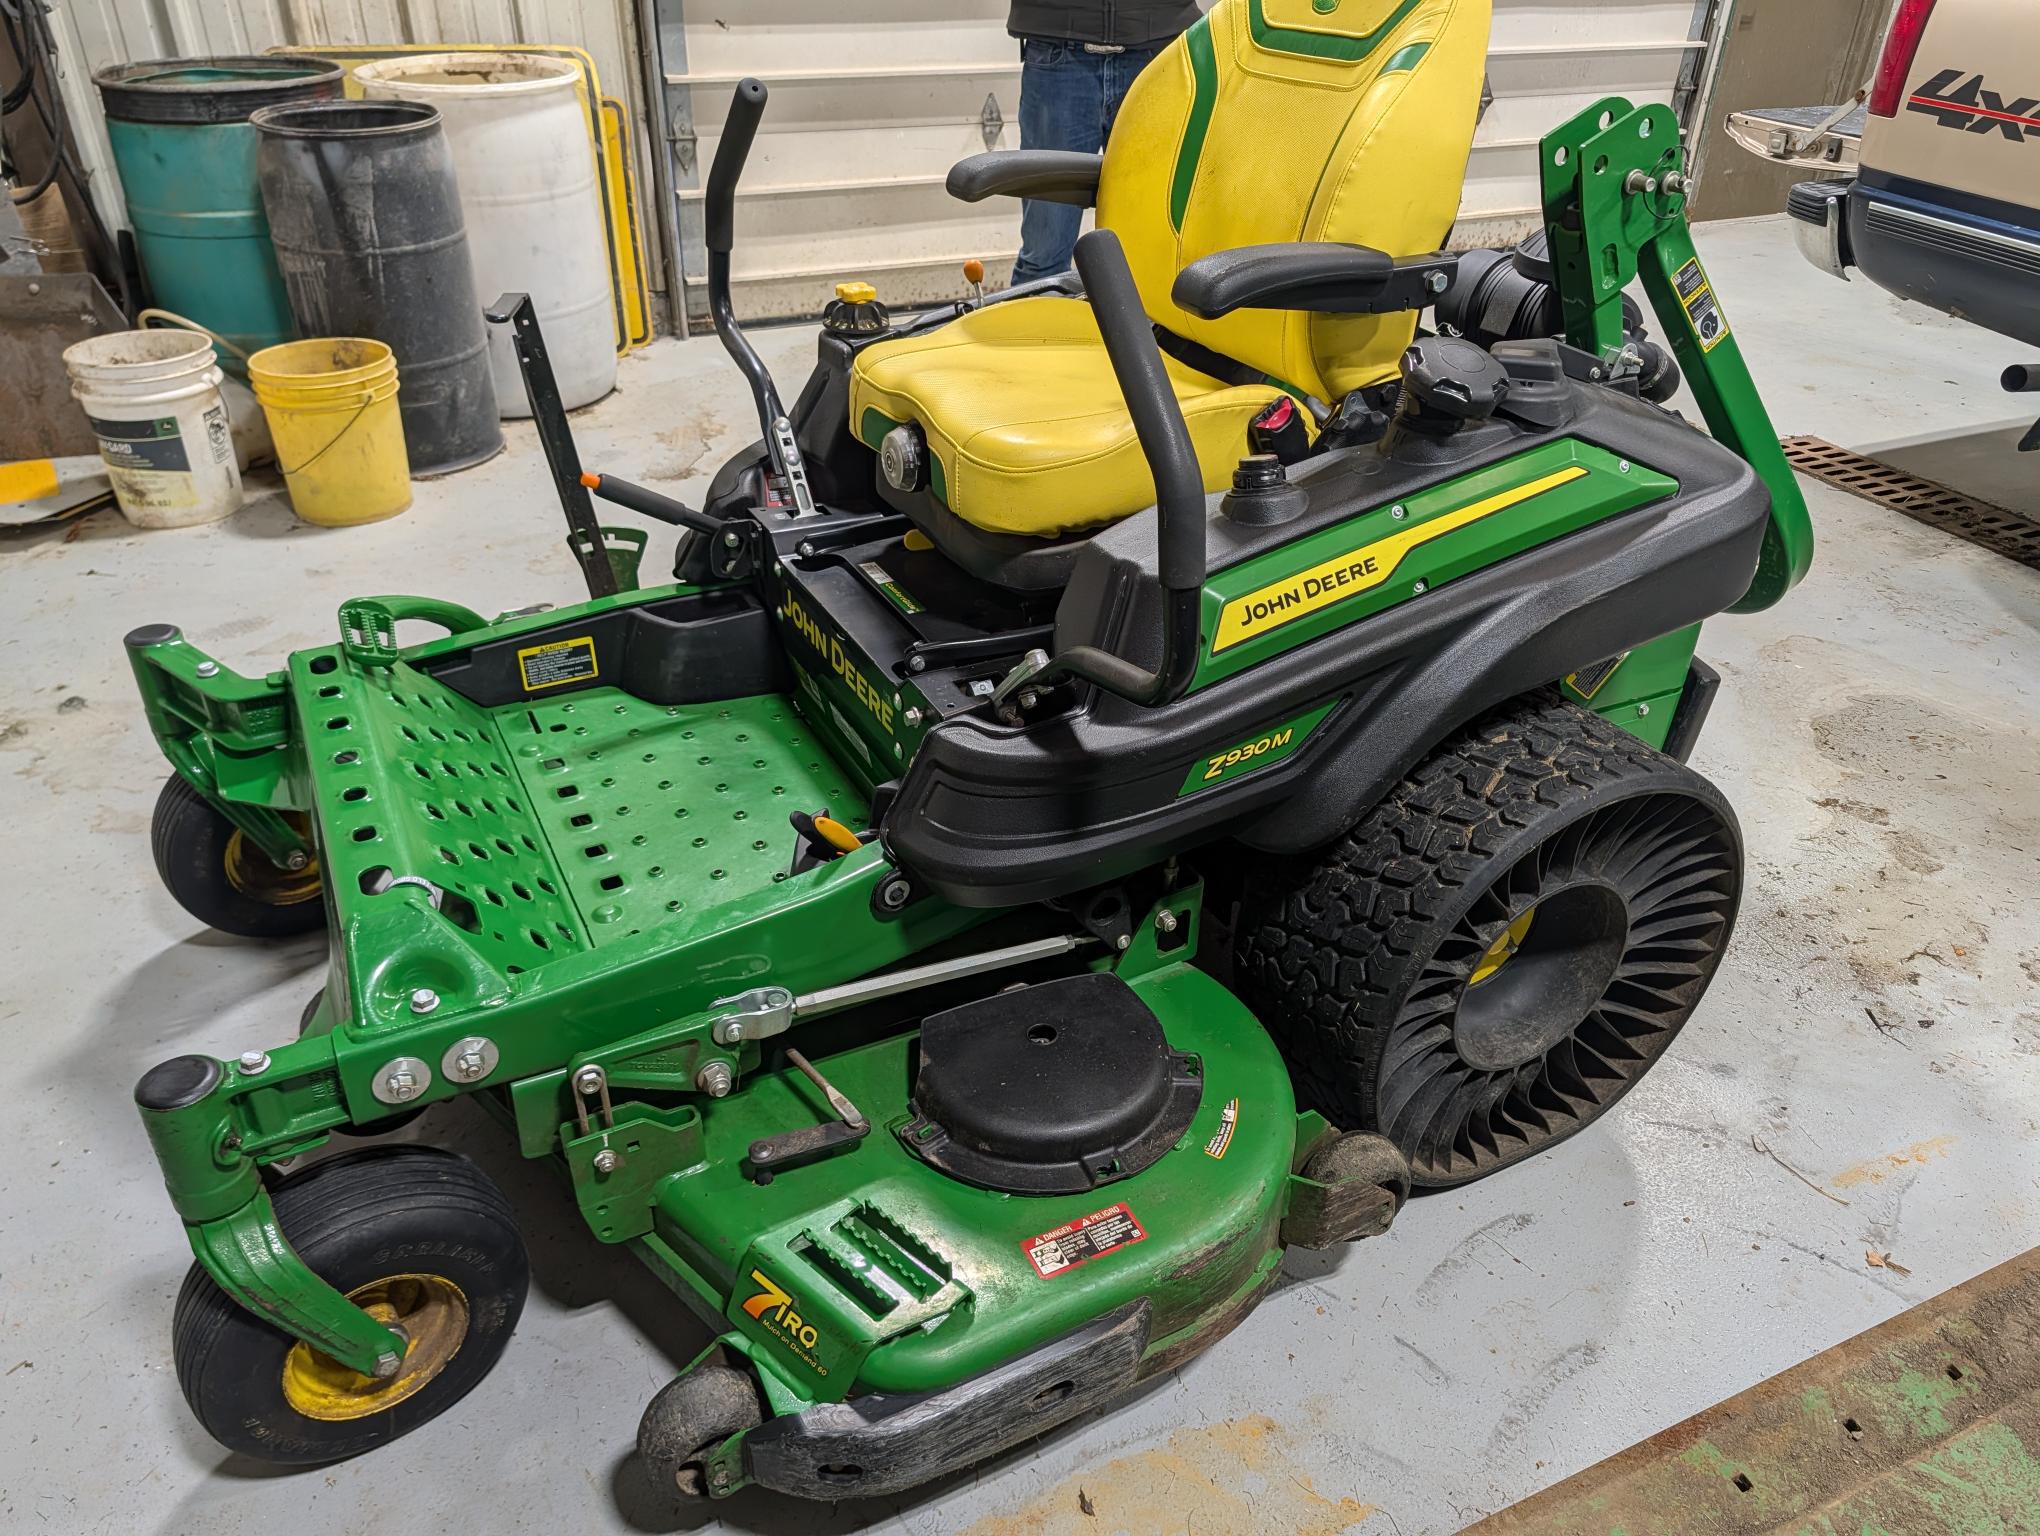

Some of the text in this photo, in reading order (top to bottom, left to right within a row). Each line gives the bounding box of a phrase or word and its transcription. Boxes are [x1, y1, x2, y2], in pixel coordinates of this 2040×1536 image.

[1241, 556, 1379, 626] JOHN DEERE
[545, 643, 569, 651] CAUTION
[783, 589, 827, 659] JOHN
[831, 637, 894, 736] DEERE
[1204, 729, 1293, 780] Z930M
[1042, 1225, 1073, 1241] DANGER
[1089, 1205, 1120, 1223] PELIGRO
[762, 1319, 827, 1377] Mulch on Demand 60
